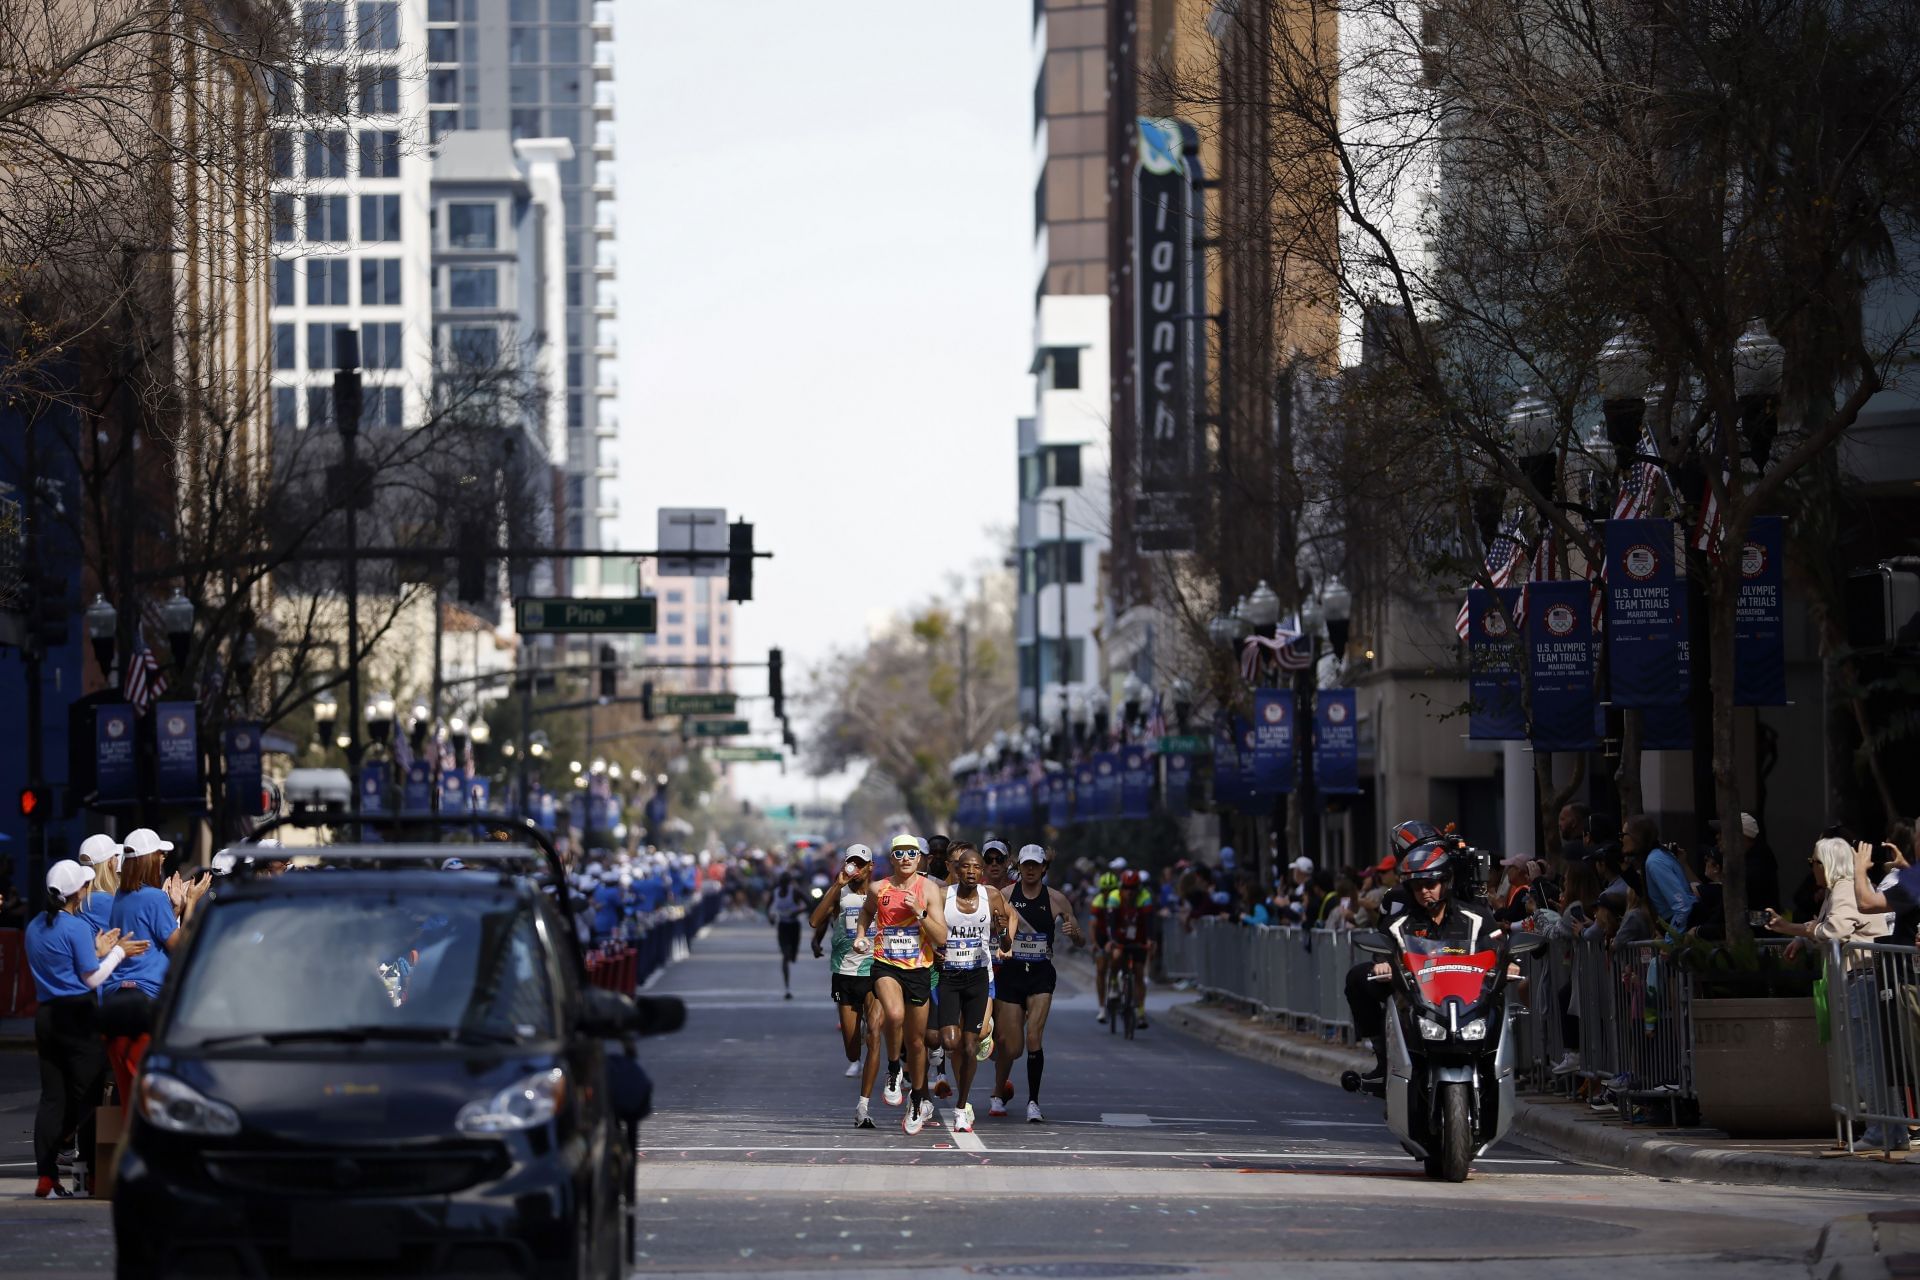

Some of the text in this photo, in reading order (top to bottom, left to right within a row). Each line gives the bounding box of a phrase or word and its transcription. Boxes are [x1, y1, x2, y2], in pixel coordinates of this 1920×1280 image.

[1151, 191, 1176, 440] launch
[1614, 587, 1669, 599] U.S. OLYMPIC
[1742, 586, 1776, 596] OLYMPIC
[1615, 599, 1670, 610] TEAM TRIALS
[1749, 597, 1777, 607] TRIALS
[566, 606, 606, 624] Pine
[1627, 610, 1658, 618] MARATHON
[1736, 608, 1765, 616] MARATHON
[1537, 642, 1586, 653] U.S. OLYMPIC
[1537, 652, 1587, 663] TEAM TRIALS
[951, 926, 985, 938] ARMY
